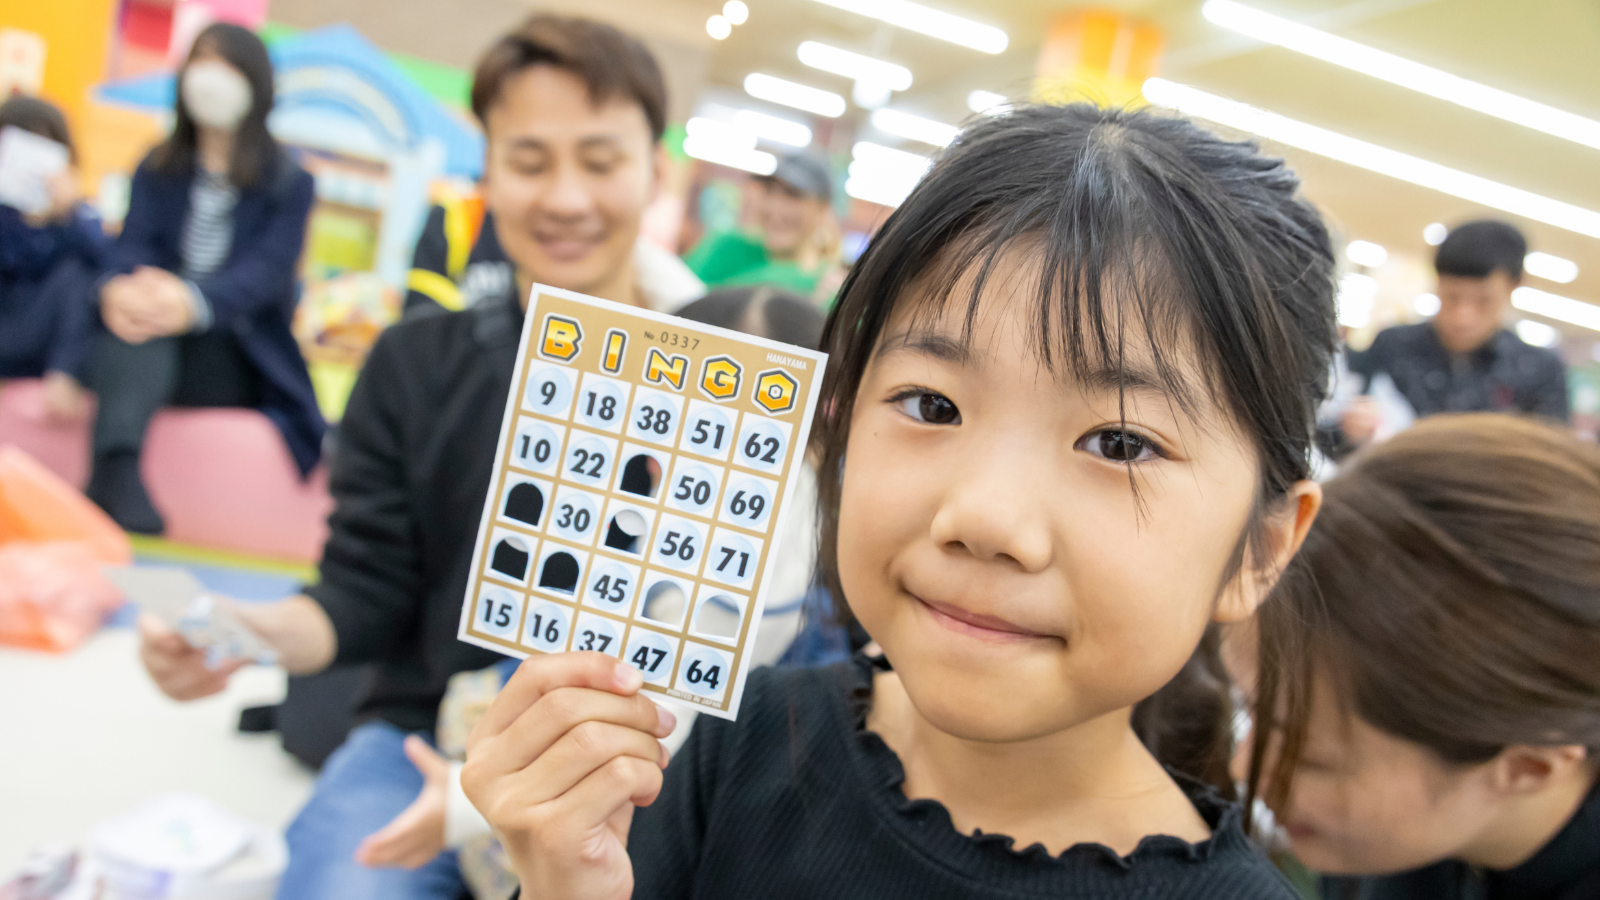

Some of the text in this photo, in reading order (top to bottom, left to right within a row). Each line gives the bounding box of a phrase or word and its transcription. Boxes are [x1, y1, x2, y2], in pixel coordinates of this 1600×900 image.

[766, 352, 807, 371] HANAYAMA
[541, 381, 780, 464] 9 18 38 51 62
[521, 435, 765, 520] 10 22 50 69
[557, 504, 749, 577] 30 56 71
[593, 575, 628, 603] 45
[484, 599, 721, 690] 15 16 37 47 64
[666, 688, 722, 709] PRINTED IN JAPAN
